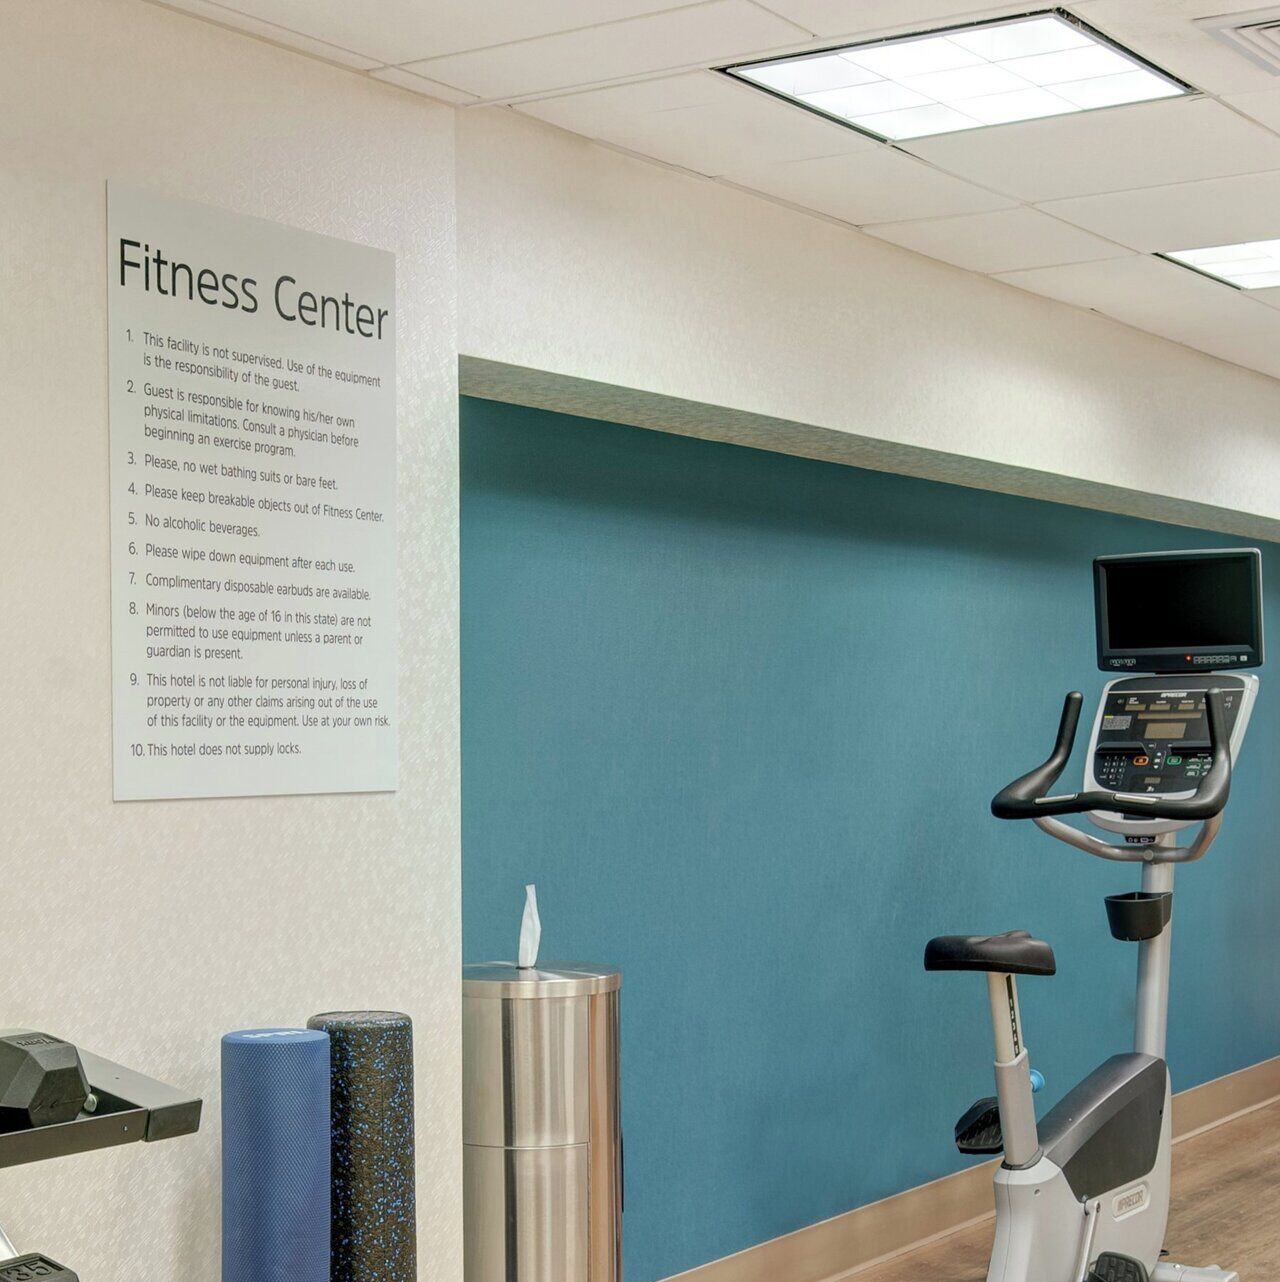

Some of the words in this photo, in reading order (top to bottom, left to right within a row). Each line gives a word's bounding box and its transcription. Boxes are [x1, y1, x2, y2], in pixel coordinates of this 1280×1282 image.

[120, 238, 258, 313] Fitness
[274, 276, 388, 339] Center
[126, 328, 134, 342] 1.
[143, 331, 164, 348] This
[167, 336, 199, 356] facility
[202, 342, 210, 357] is
[212, 347, 229, 360] not
[232, 351, 284, 370] supervised.
[286, 359, 304, 374] Use
[306, 363, 316, 375] of
[317, 365, 333, 379] the
[334, 370, 381, 388] equipment
[143, 352, 152, 367] is
[154, 355, 172, 370] the
[175, 361, 239, 382] responsibility
[241, 370, 251, 383] of
[254, 373, 270, 387] the
[272, 378, 300, 392] guest.
[126, 379, 136, 393] 2.
[143, 382, 174, 400] Guest
[176, 387, 185, 402] is
[188, 393, 243, 411] responsible
[246, 399, 259, 413] for
[262, 402, 301, 422] knowing
[303, 409, 334, 425] his/her
[336, 416, 355, 428] own
[144, 404, 185, 421] physical
[187, 410, 240, 430] limitations.
[242, 418, 277, 436] Consult
[278, 426, 286, 437] a
[287, 426, 328, 442] physician
[330, 432, 359, 448] before
[144, 424, 195, 445] beginning
[197, 434, 211, 445] an
[213, 436, 252, 451] exercise
[254, 442, 296, 457] program.
[127, 451, 137, 465] 3.
[144, 453, 180, 471] Please,
[183, 461, 197, 473] no
[199, 463, 218, 476] wet
[221, 464, 257, 482] bathing
[259, 470, 281, 484] suits
[283, 474, 293, 485] or
[296, 474, 317, 488] bare
[318, 476, 338, 490] feet.
[127, 482, 138, 495] 4.
[145, 483, 178, 500] Please
[181, 488, 206, 504] keep
[208, 491, 255, 509] breakable
[258, 497, 292, 513] objects
[293, 503, 309, 514] out
[311, 503, 321, 516] of
[323, 504, 353, 519] Fitness
[355, 507, 384, 522] Center.
[128, 511, 138, 525] 5.
[145, 513, 160, 528] No
[163, 516, 206, 532] alcoholic
[209, 520, 260, 538] beverages.
[128, 541, 138, 555] 6.
[145, 543, 179, 559] Please
[181, 548, 206, 561] wipe
[208, 549, 236, 563] down
[239, 554, 289, 567] equipment
[291, 556, 312, 570] after
[314, 559, 336, 571] each
[338, 562, 356, 573] use.
[128, 571, 137, 585] 7.
[145, 573, 221, 592] Complimentary
[224, 579, 274, 595] disposable
[276, 584, 314, 597] earbuds
[315, 587, 330, 598] are
[332, 588, 371, 601] available.
[128, 601, 139, 615] 8.
[146, 603, 180, 618] Minors
[183, 605, 217, 619] (below
[219, 607, 236, 621] the
[238, 610, 256, 623] age
[258, 609, 268, 622] of
[271, 610, 282, 623] 16
[284, 611, 293, 623] in
[295, 612, 312, 624] this
[313, 613, 338, 627] state)
[340, 616, 355, 627] are
[357, 617, 372, 627] not
[146, 645, 191, 659] guardian
[193, 645, 202, 659] is
[204, 648, 243, 660] present.
[129, 672, 140, 686] 9.
[146, 673, 167, 687] This
[170, 674, 195, 687] hotel
[198, 675, 206, 688] is
[209, 676, 225, 688] not
[228, 675, 253, 688] liable
[255, 675, 269, 689] for
[271, 677, 310, 689] personal
[312, 677, 338, 691] injury,
[340, 678, 357, 690] loss
[358, 678, 368, 690] of
[146, 713, 158, 727] of
[160, 714, 179, 727] this
[181, 714, 213, 729] facility
[215, 716, 226, 727] or
[229, 714, 245, 727] the
[247, 715, 299, 728] equipment.
[302, 714, 319, 727] Use
[320, 715, 330, 727] at
[332, 717, 351, 728] your
[353, 717, 372, 727] own
[374, 715, 391, 727] risk.
[130, 743, 146, 757] 10.
[147, 743, 168, 756] This
[170, 743, 196, 756] hotel
[198, 743, 223, 756] does
[225, 744, 242, 755] not
[244, 743, 275, 756] supply
[277, 742, 302, 755] locks.
[14, 1261, 53, 1282] 35
